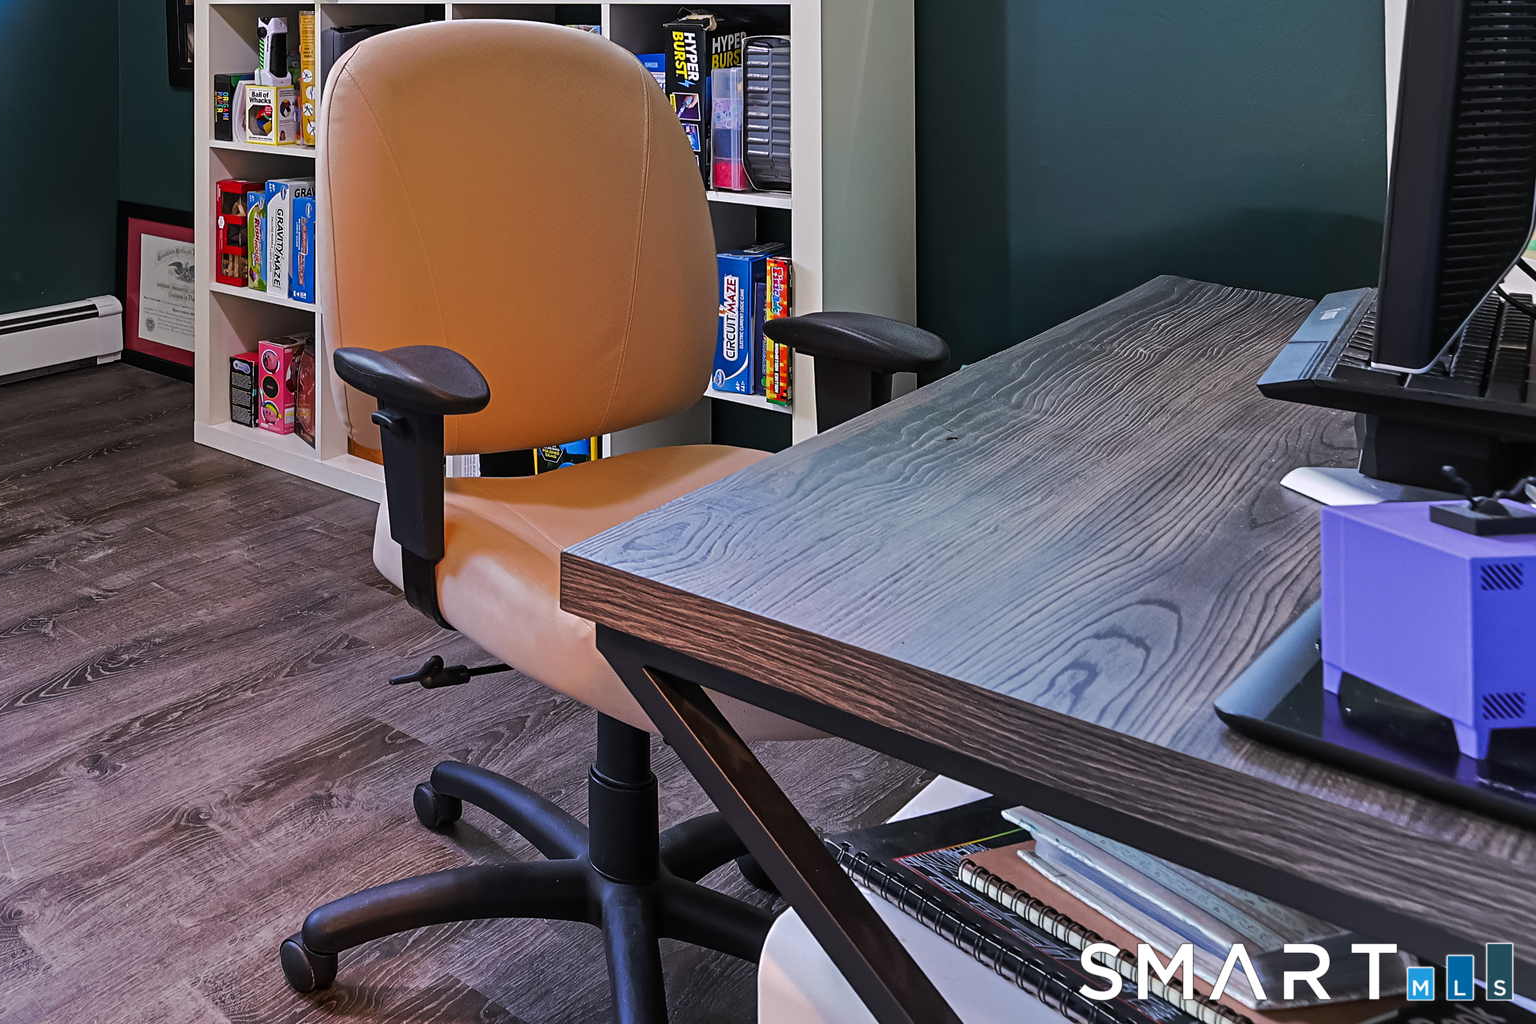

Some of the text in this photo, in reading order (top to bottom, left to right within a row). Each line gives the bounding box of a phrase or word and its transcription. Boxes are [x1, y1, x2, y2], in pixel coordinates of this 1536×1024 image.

[683, 32, 700, 81] HYPER
[216, 91, 224, 113] PAPER
[222, 91, 230, 121] ORIGAMI
[273, 208, 284, 287] GRAVITY MAZE
[726, 278, 736, 359] CIRCUIT MAZE
